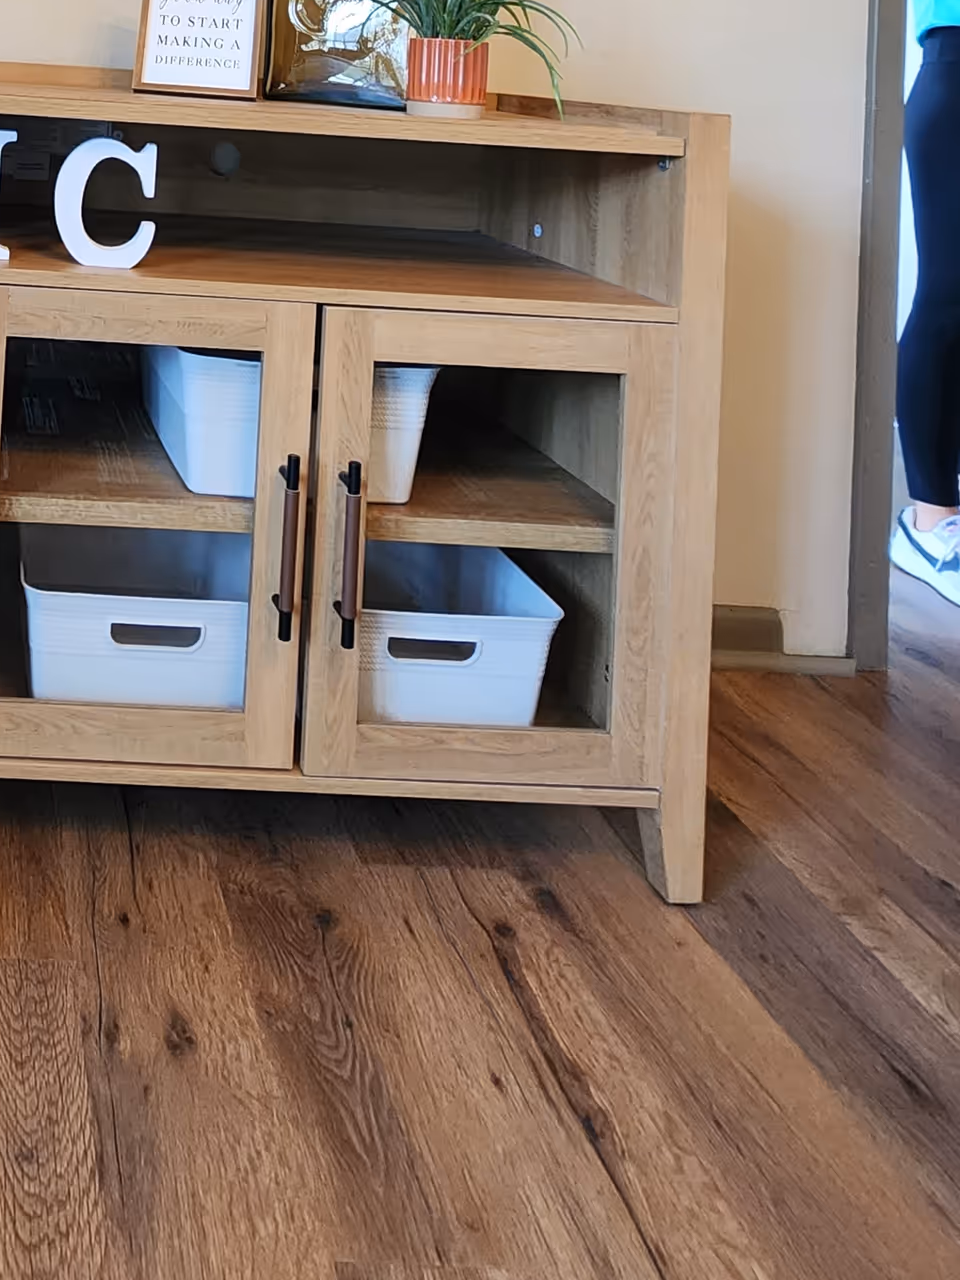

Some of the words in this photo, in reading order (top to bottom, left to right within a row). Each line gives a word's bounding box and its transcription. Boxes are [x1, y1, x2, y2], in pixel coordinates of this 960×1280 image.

[159, 14, 181, 27] TO
[187, 16, 243, 30] START
[157, 34, 224, 50] MAKING
[230, 39, 241, 51] A
[154, 54, 241, 70] DIFFERENCE
